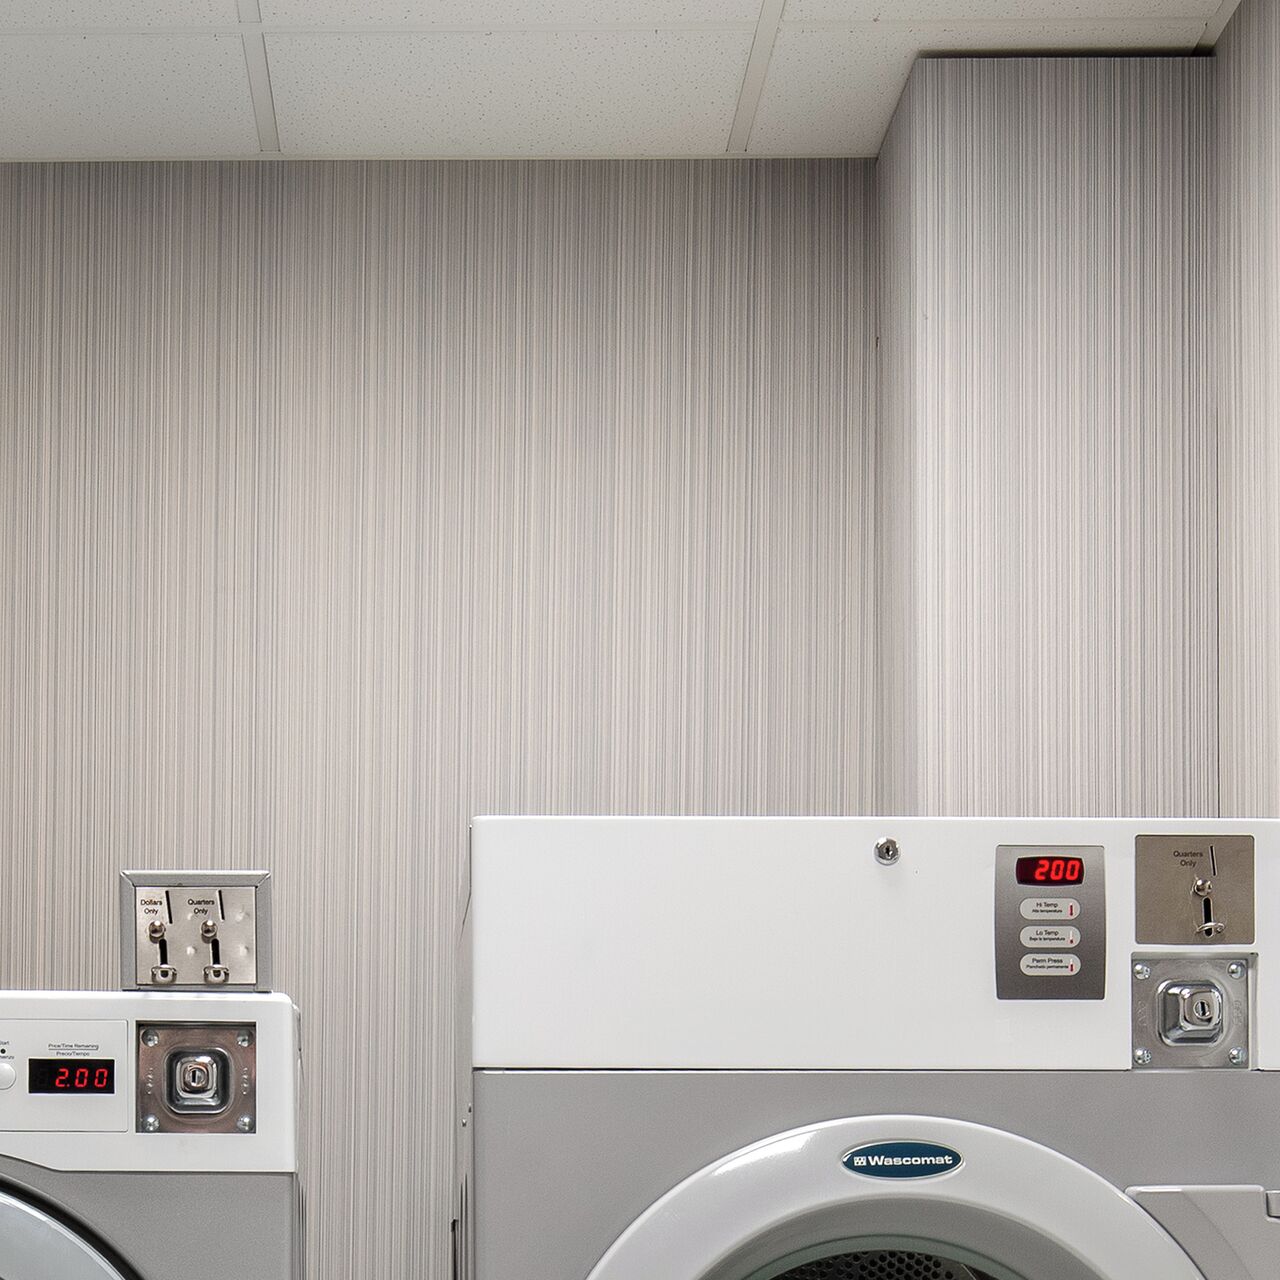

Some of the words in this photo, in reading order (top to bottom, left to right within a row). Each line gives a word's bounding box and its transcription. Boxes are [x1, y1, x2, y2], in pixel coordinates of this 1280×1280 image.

[1180, 860, 1197, 868] Only
[143, 907, 159, 916] Only
[193, 907, 209, 915] Only
[867, 1155, 953, 1166] Wascomat
